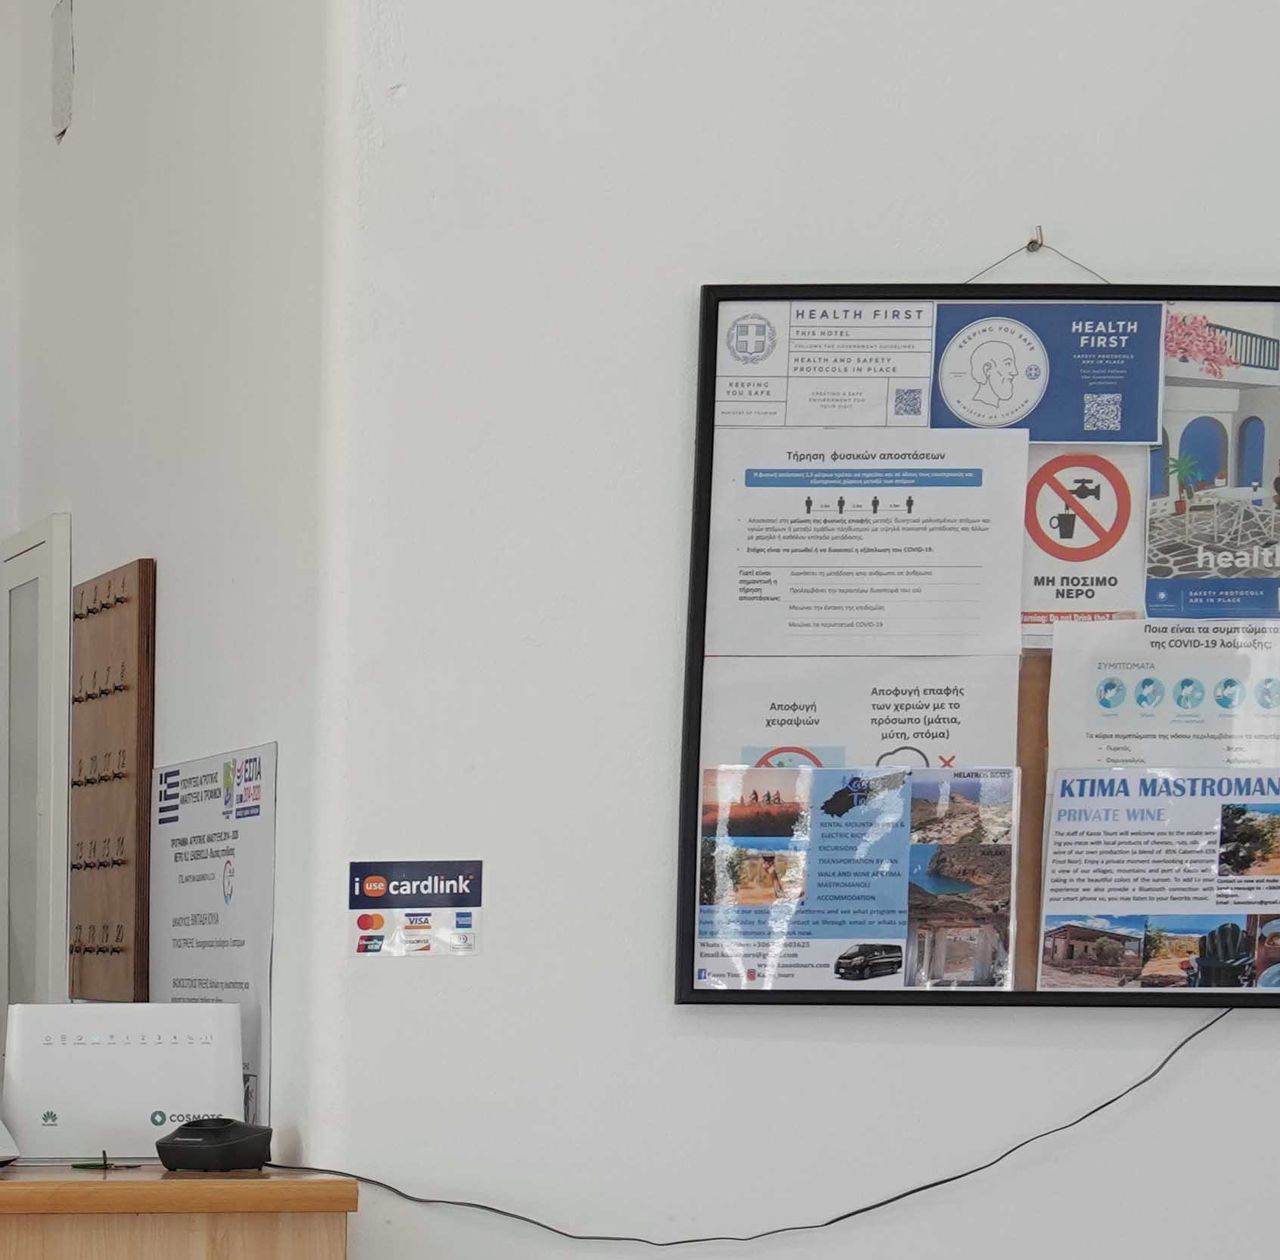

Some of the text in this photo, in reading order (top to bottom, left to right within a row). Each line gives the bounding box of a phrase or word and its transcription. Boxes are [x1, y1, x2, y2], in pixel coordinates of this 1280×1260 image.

[796, 310, 924, 319] HEALTH FIRST
[1072, 322, 1138, 333] HEALTH
[958, 327, 1035, 352] KEEPING YOU SAFE
[1080, 336, 1128, 347] FIRST
[787, 451, 945, 462] Τήρηση φυσικών αποστάσεων
[1034, 576, 1118, 586] ΜΗ ΠΟΣΙΜΟ
[1056, 589, 1095, 599] ΝΕΡΟ
[1144, 625, 1167, 634] Ποια
[1170, 625, 1195, 633] είναι
[1150, 639, 1272, 650] της COVID-19 λοίμωξης;
[871, 687, 964, 697] Αποφυγή επαφής
[770, 702, 817, 712] Αποφυγή
[872, 702, 890, 710] των
[893, 701, 929, 711] χεριών
[933, 702, 945, 711] με
[765, 717, 820, 727] χειραψιών
[871, 716, 960, 726] πρόσωπο (μάτια,
[881, 730, 949, 740] μύτη, στόμα)
[243, 755, 261, 782] ΕΣΠΑ
[1060, 778, 1280, 797] KTIMA MASTROMAN
[1057, 809, 1166, 822] PRIVATE WINE
[354, 875, 470, 895] i use cardlink
